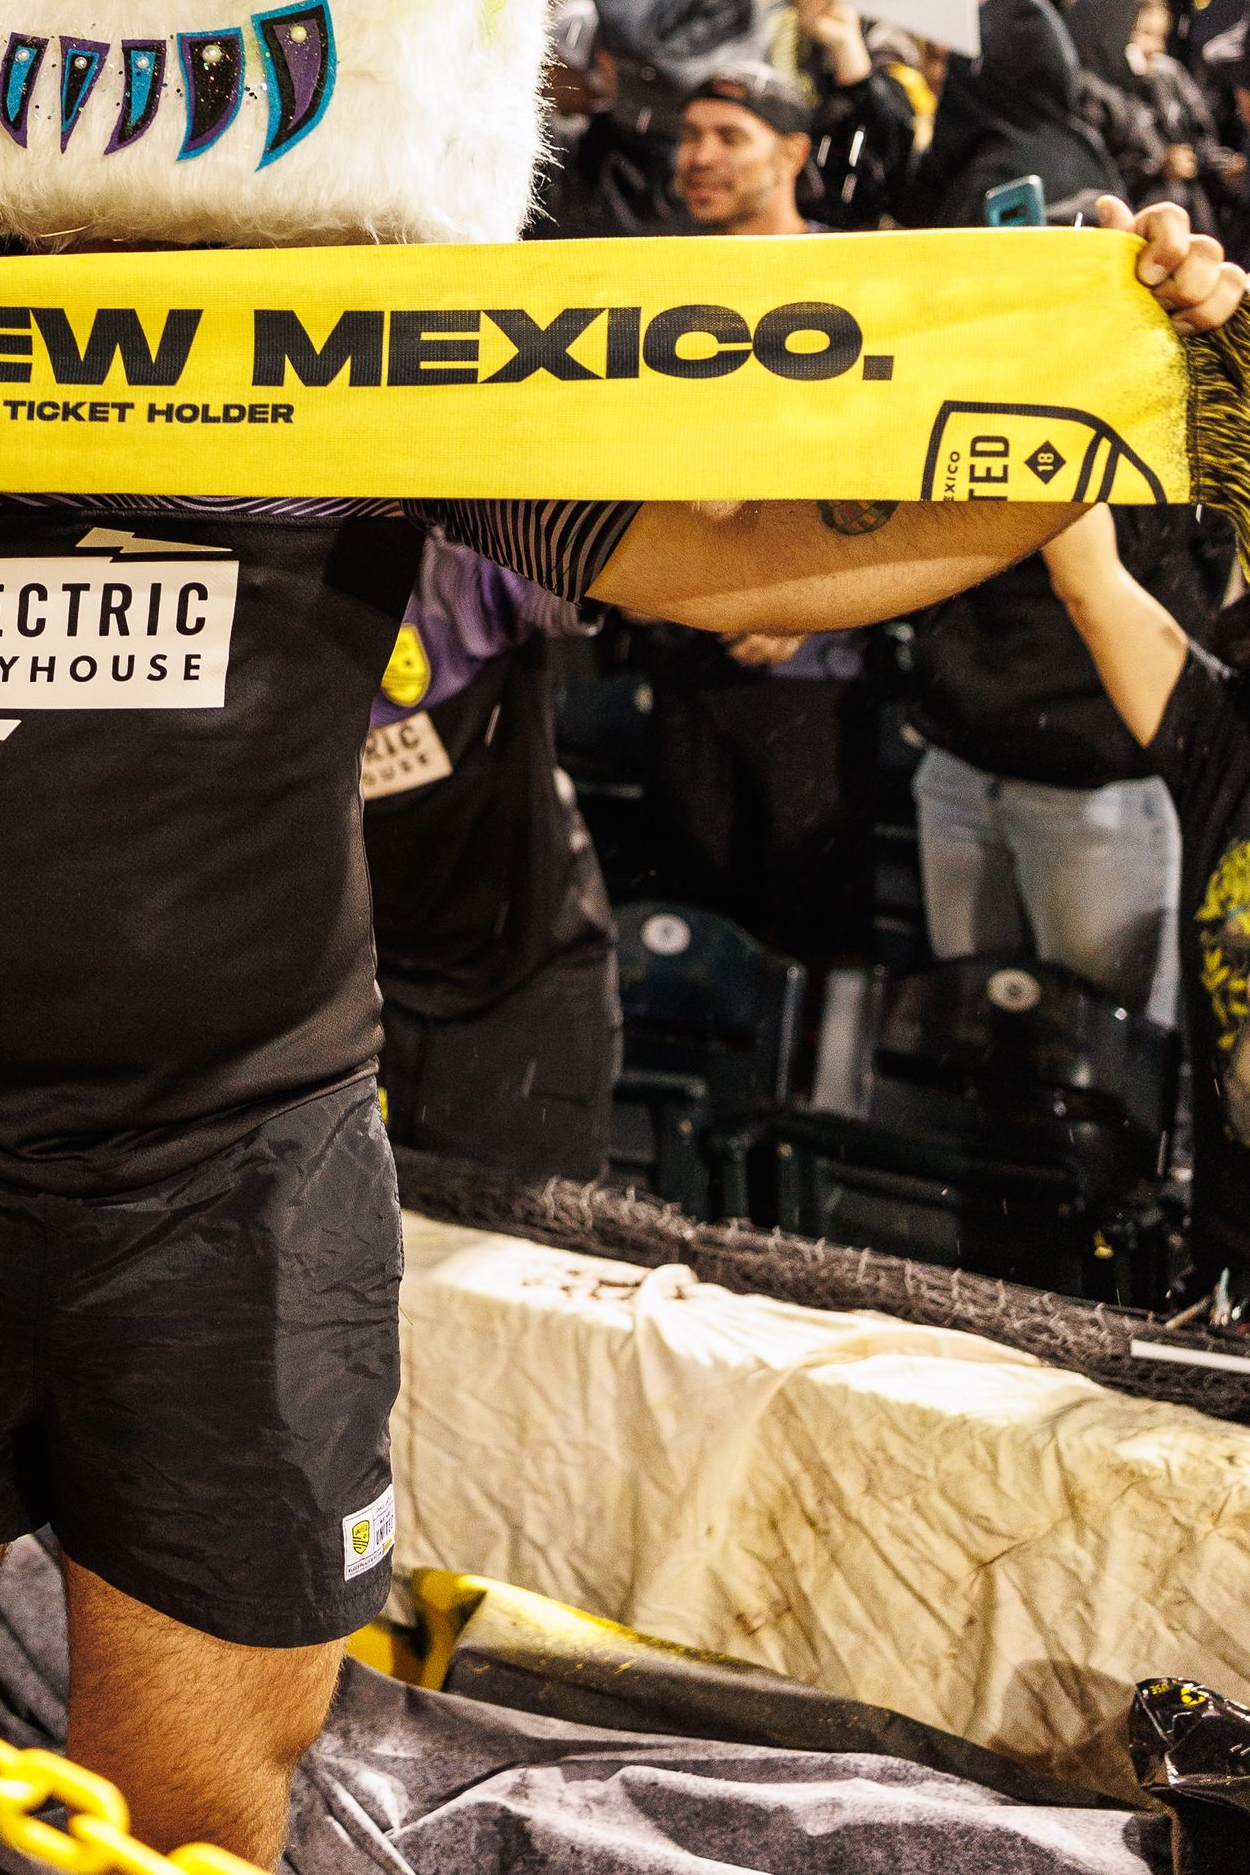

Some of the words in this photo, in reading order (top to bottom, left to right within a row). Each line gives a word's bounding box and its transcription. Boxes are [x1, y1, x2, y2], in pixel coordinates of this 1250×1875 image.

[251, 300, 895, 388] MEXICO.
[3, 398, 134, 423] TICKET
[148, 401, 295, 425] HOLDER
[1038, 452, 1054, 472] 18
